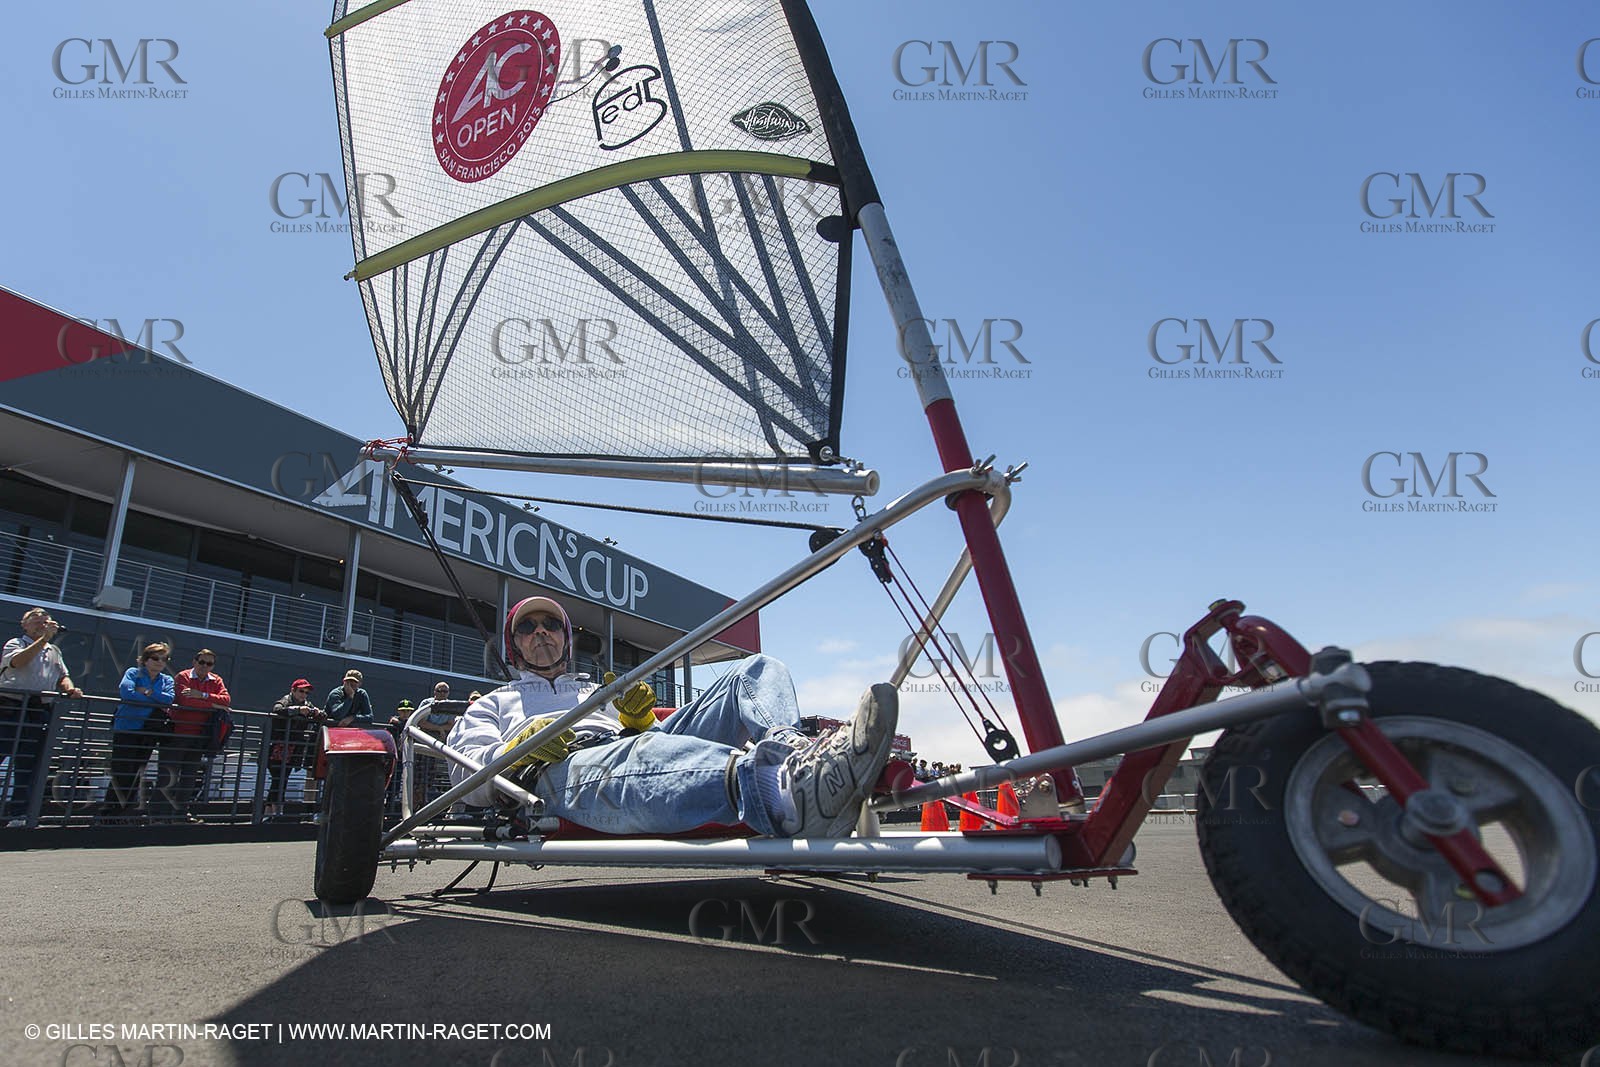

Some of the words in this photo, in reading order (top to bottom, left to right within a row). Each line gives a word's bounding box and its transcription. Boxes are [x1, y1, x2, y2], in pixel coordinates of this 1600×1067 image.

[457, 103, 517, 148] OPEN
[439, 147, 456, 173] SAN
[455, 143, 516, 179] FRANCISCO
[579, 550, 649, 611] CUP
